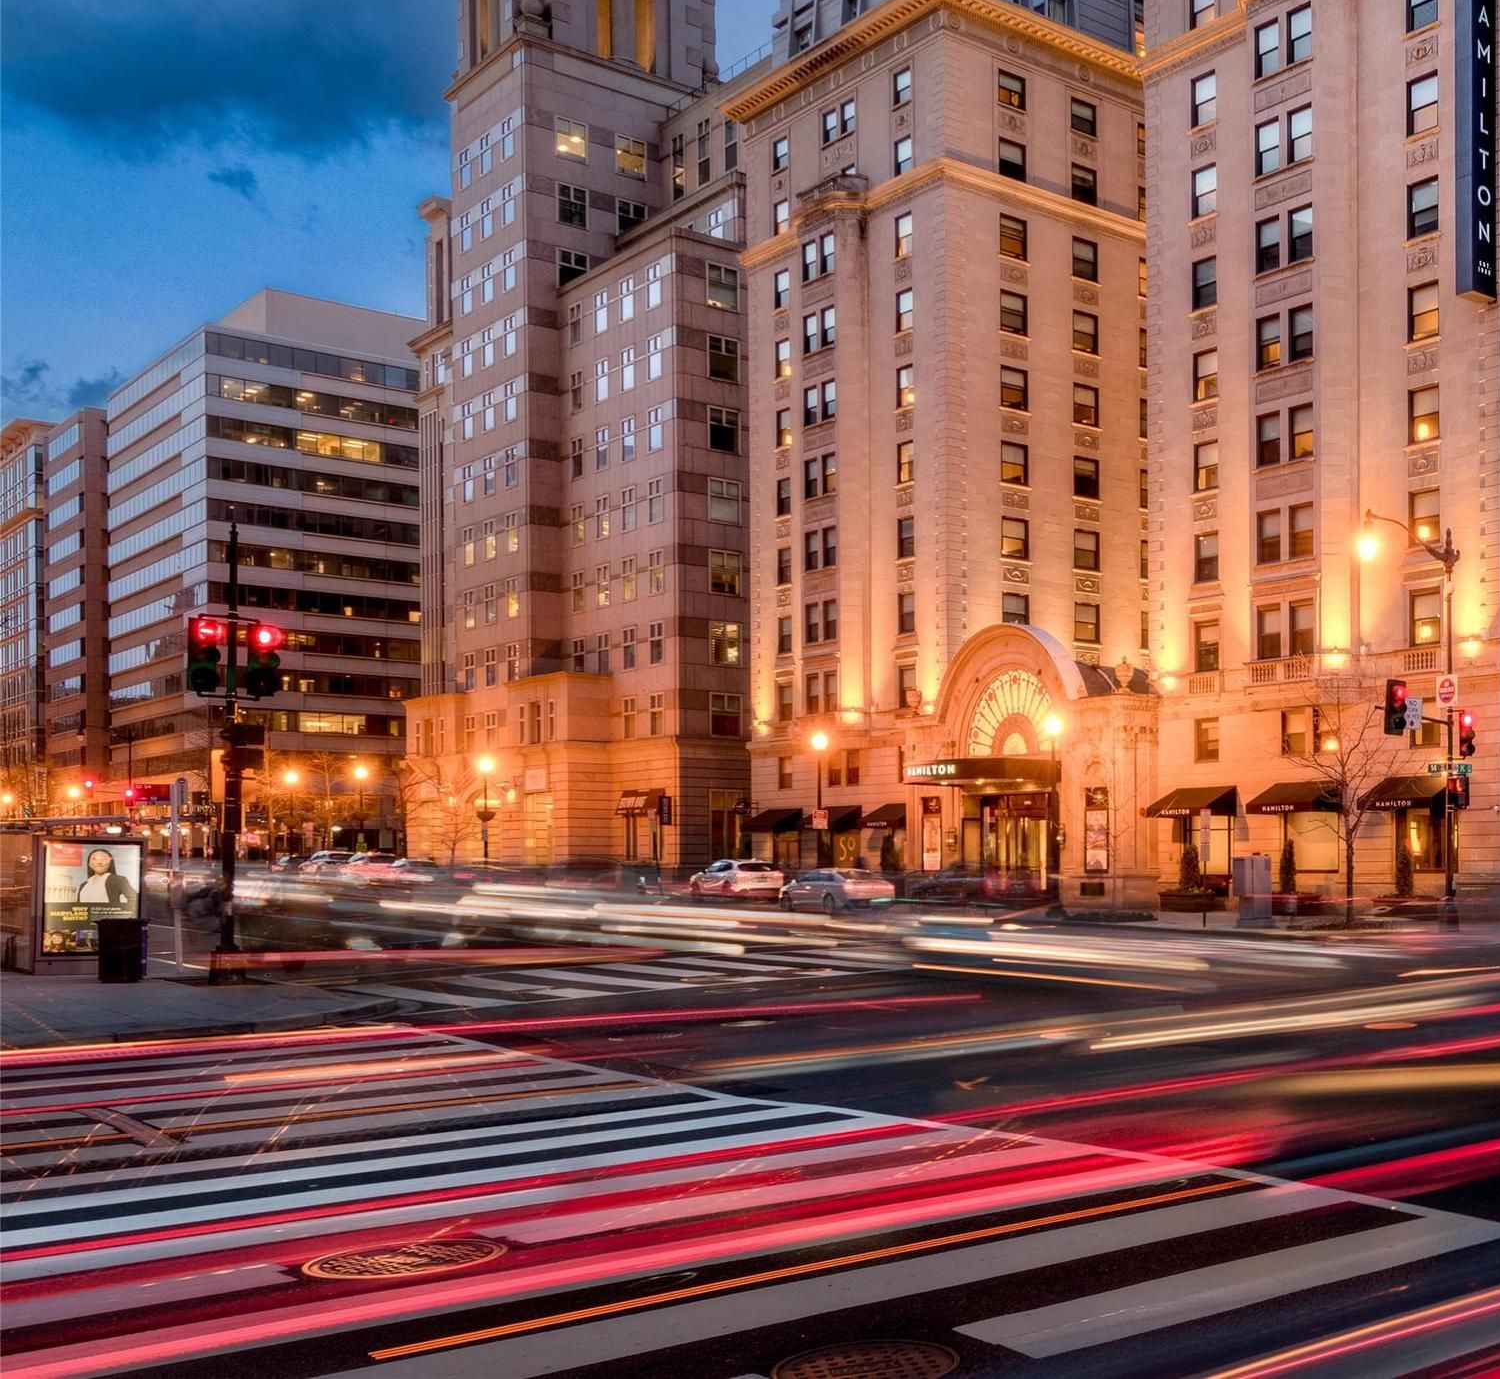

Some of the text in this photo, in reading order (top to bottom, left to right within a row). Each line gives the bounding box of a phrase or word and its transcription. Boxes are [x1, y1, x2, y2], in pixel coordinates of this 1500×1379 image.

[906, 763, 956, 777] HAMILTON
[1261, 804, 1295, 812] HAMILTON
[1375, 800, 1412, 808] HAMILTON
[1161, 808, 1190, 816] HAMILTON
